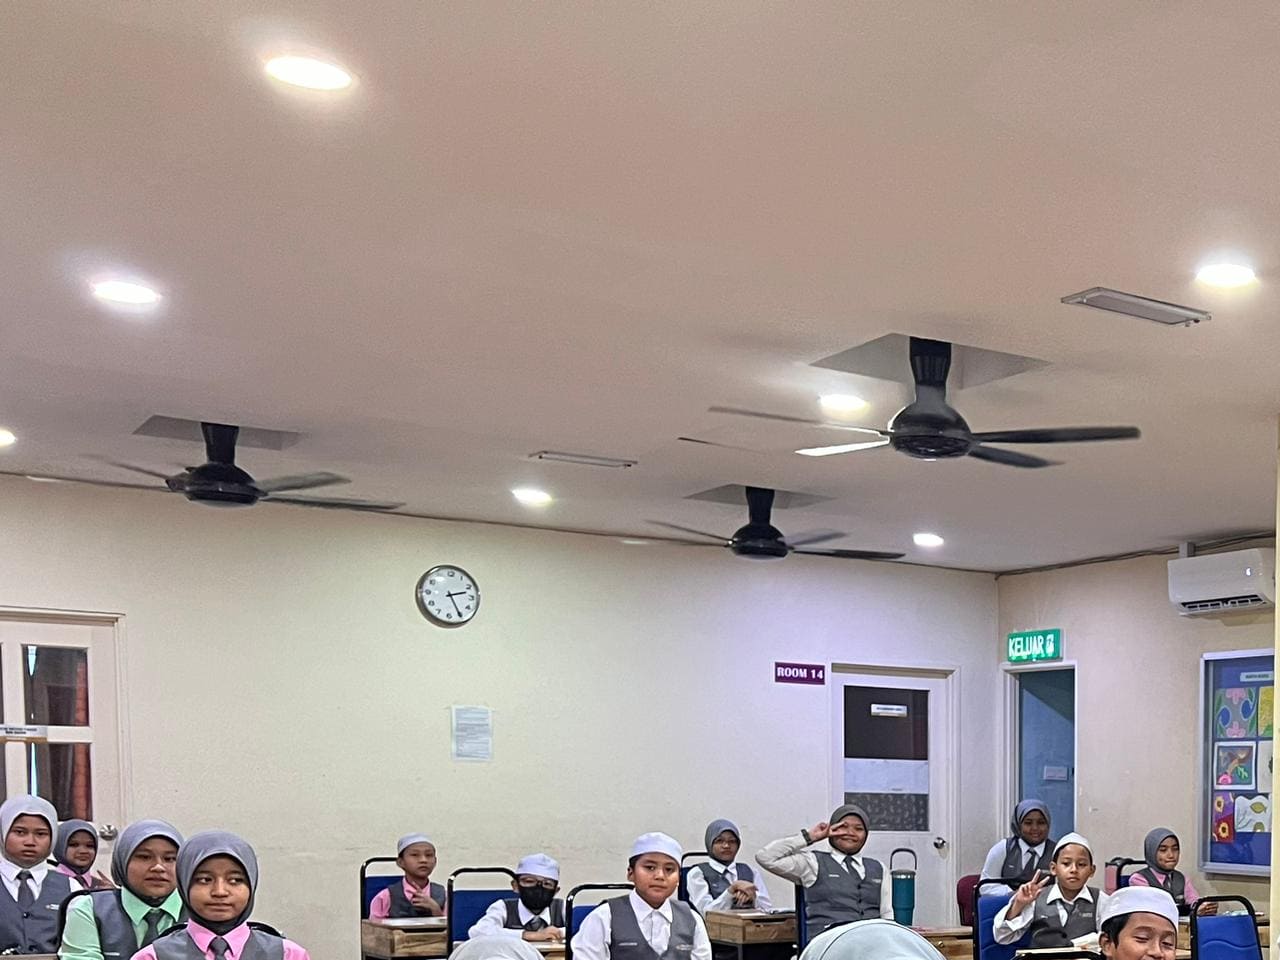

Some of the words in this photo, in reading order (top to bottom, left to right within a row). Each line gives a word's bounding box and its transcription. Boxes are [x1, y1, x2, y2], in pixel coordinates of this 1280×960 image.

[1009, 635, 1045, 657] KELUAR
[777, 667, 807, 678] ROOM
[811, 669, 823, 679] 14
